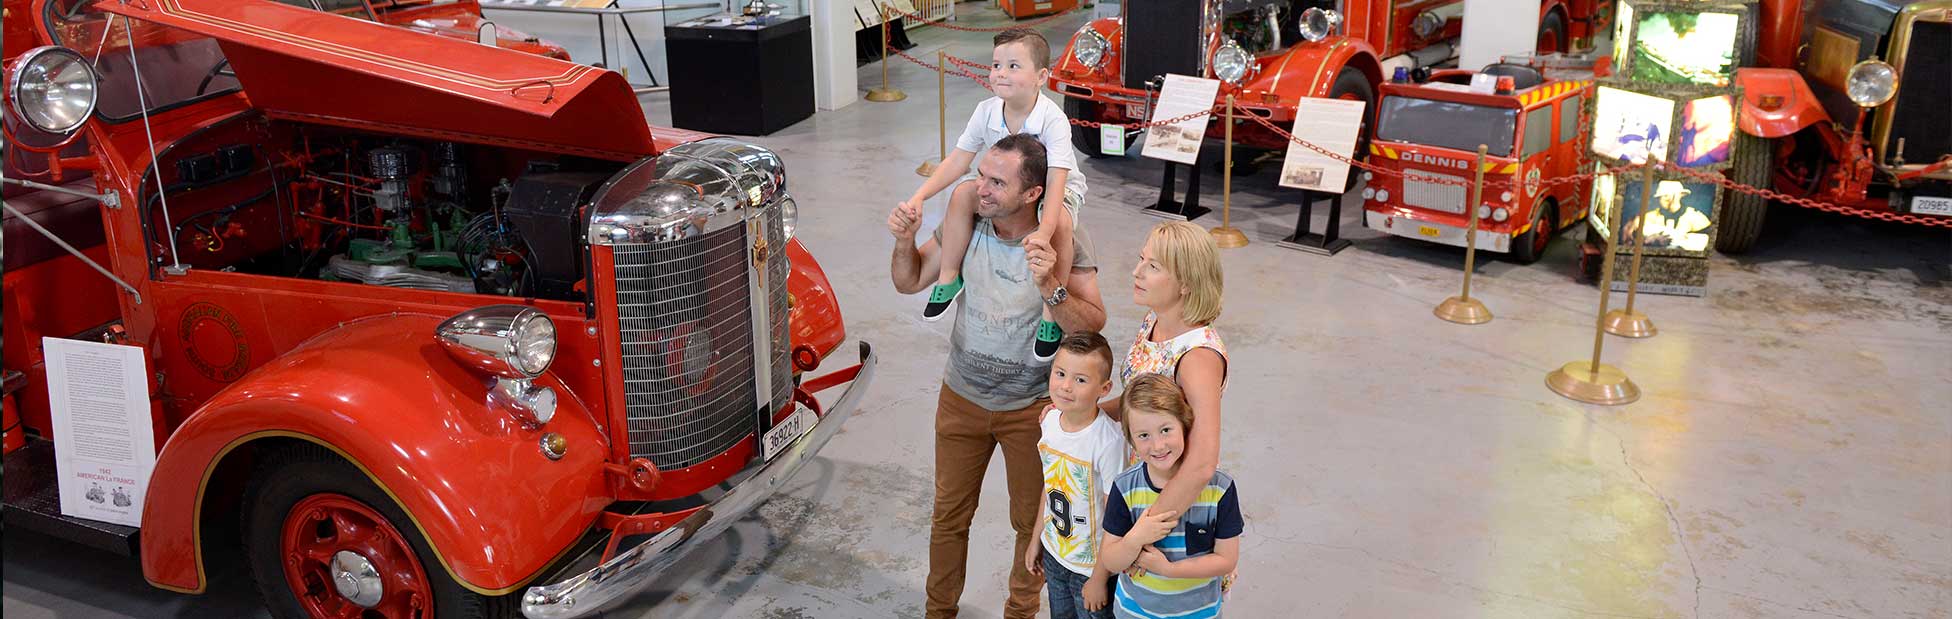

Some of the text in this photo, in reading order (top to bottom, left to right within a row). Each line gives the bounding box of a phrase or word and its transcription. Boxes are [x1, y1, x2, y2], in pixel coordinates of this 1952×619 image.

[1401, 151, 1468, 169] DENNIS
[1918, 199, 1949, 210] 20985
[991, 365, 1020, 376] THEORY
[769, 415, 800, 451] 36922 H
